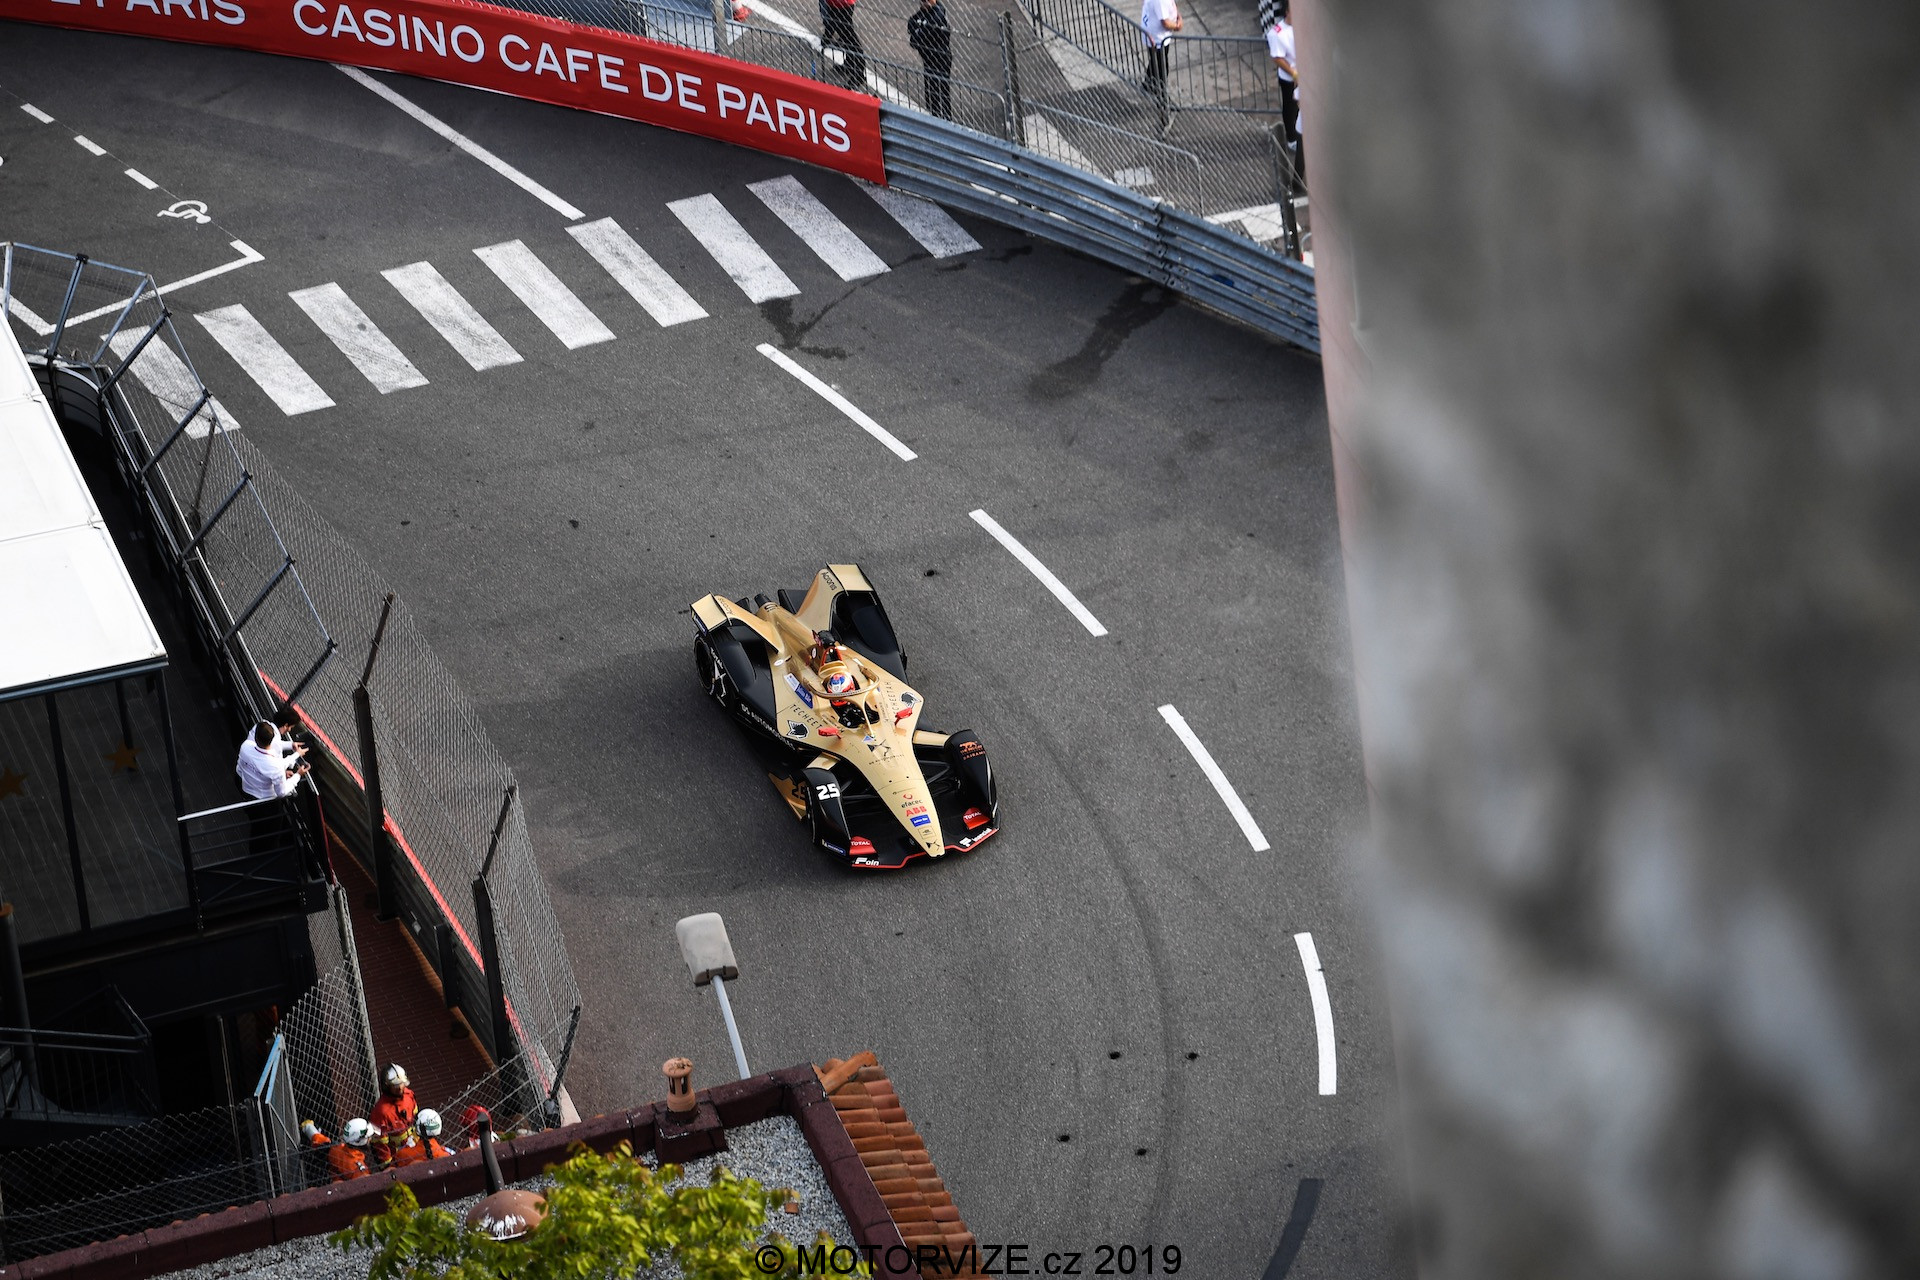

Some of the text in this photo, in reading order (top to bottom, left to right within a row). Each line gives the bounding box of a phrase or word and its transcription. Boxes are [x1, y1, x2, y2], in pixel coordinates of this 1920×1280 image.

[293, 0, 852, 153] CASINO CAFE DE PARIS
[816, 783, 841, 801] 25
[906, 805, 928, 817] ABB
[963, 811, 982, 820] TOTAL
